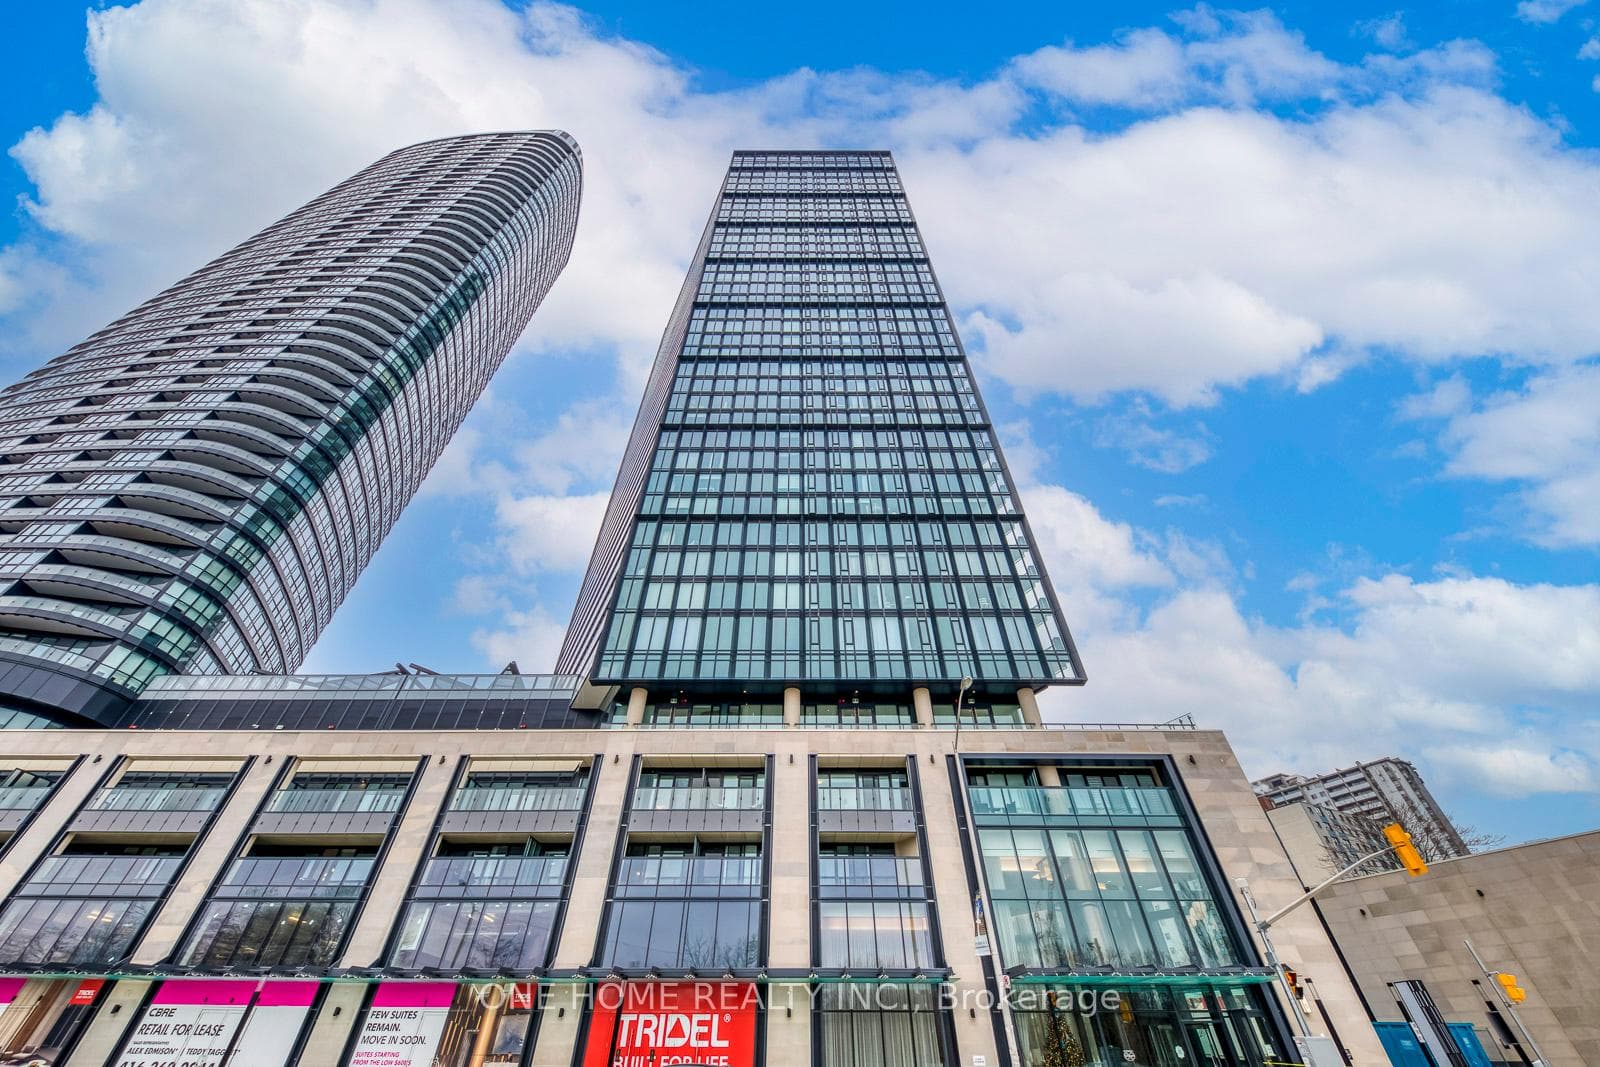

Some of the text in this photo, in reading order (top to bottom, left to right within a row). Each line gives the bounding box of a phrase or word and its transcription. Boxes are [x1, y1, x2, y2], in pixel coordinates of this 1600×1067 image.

[149, 1008, 176, 1017] CBRE
[371, 1011, 418, 1019] FEW SUITES
[138, 1024, 225, 1037] RETAIL FOR LEASE
[366, 1023, 401, 1031] REMAIN.
[361, 1036, 426, 1044] MOVE IN SOON.
[127, 1047, 143, 1055] ALEX
[186, 1048, 207, 1056] TEDDY
[352, 1059, 369, 1067] FROM
